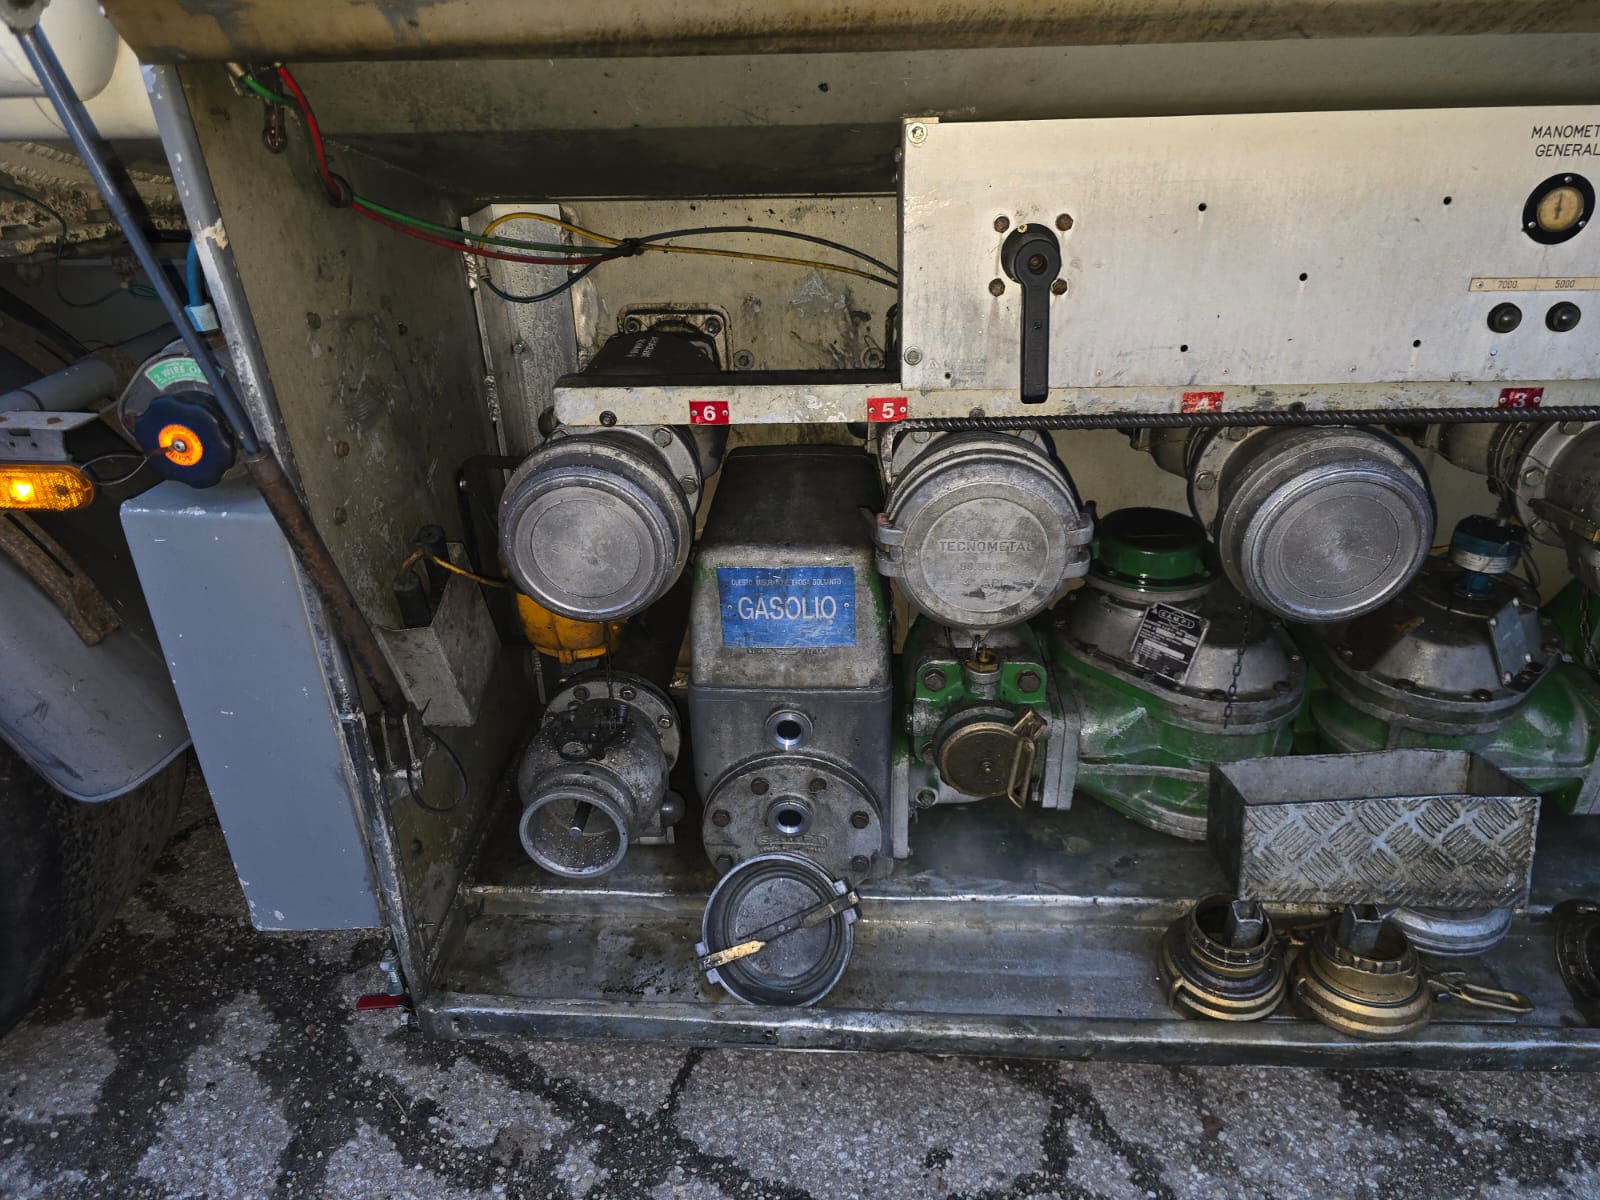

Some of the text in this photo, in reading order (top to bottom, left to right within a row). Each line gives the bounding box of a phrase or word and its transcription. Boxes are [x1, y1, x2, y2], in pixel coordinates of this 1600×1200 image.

[1498, 280, 1518, 289] 7000
[1554, 280, 1576, 289] 5000
[1512, 392, 1528, 408] 3
[703, 405, 716, 421] 6
[881, 402, 894, 418] 5
[939, 541, 1034, 552] TECNOMETAL
[737, 595, 837, 620] GASOLIO
